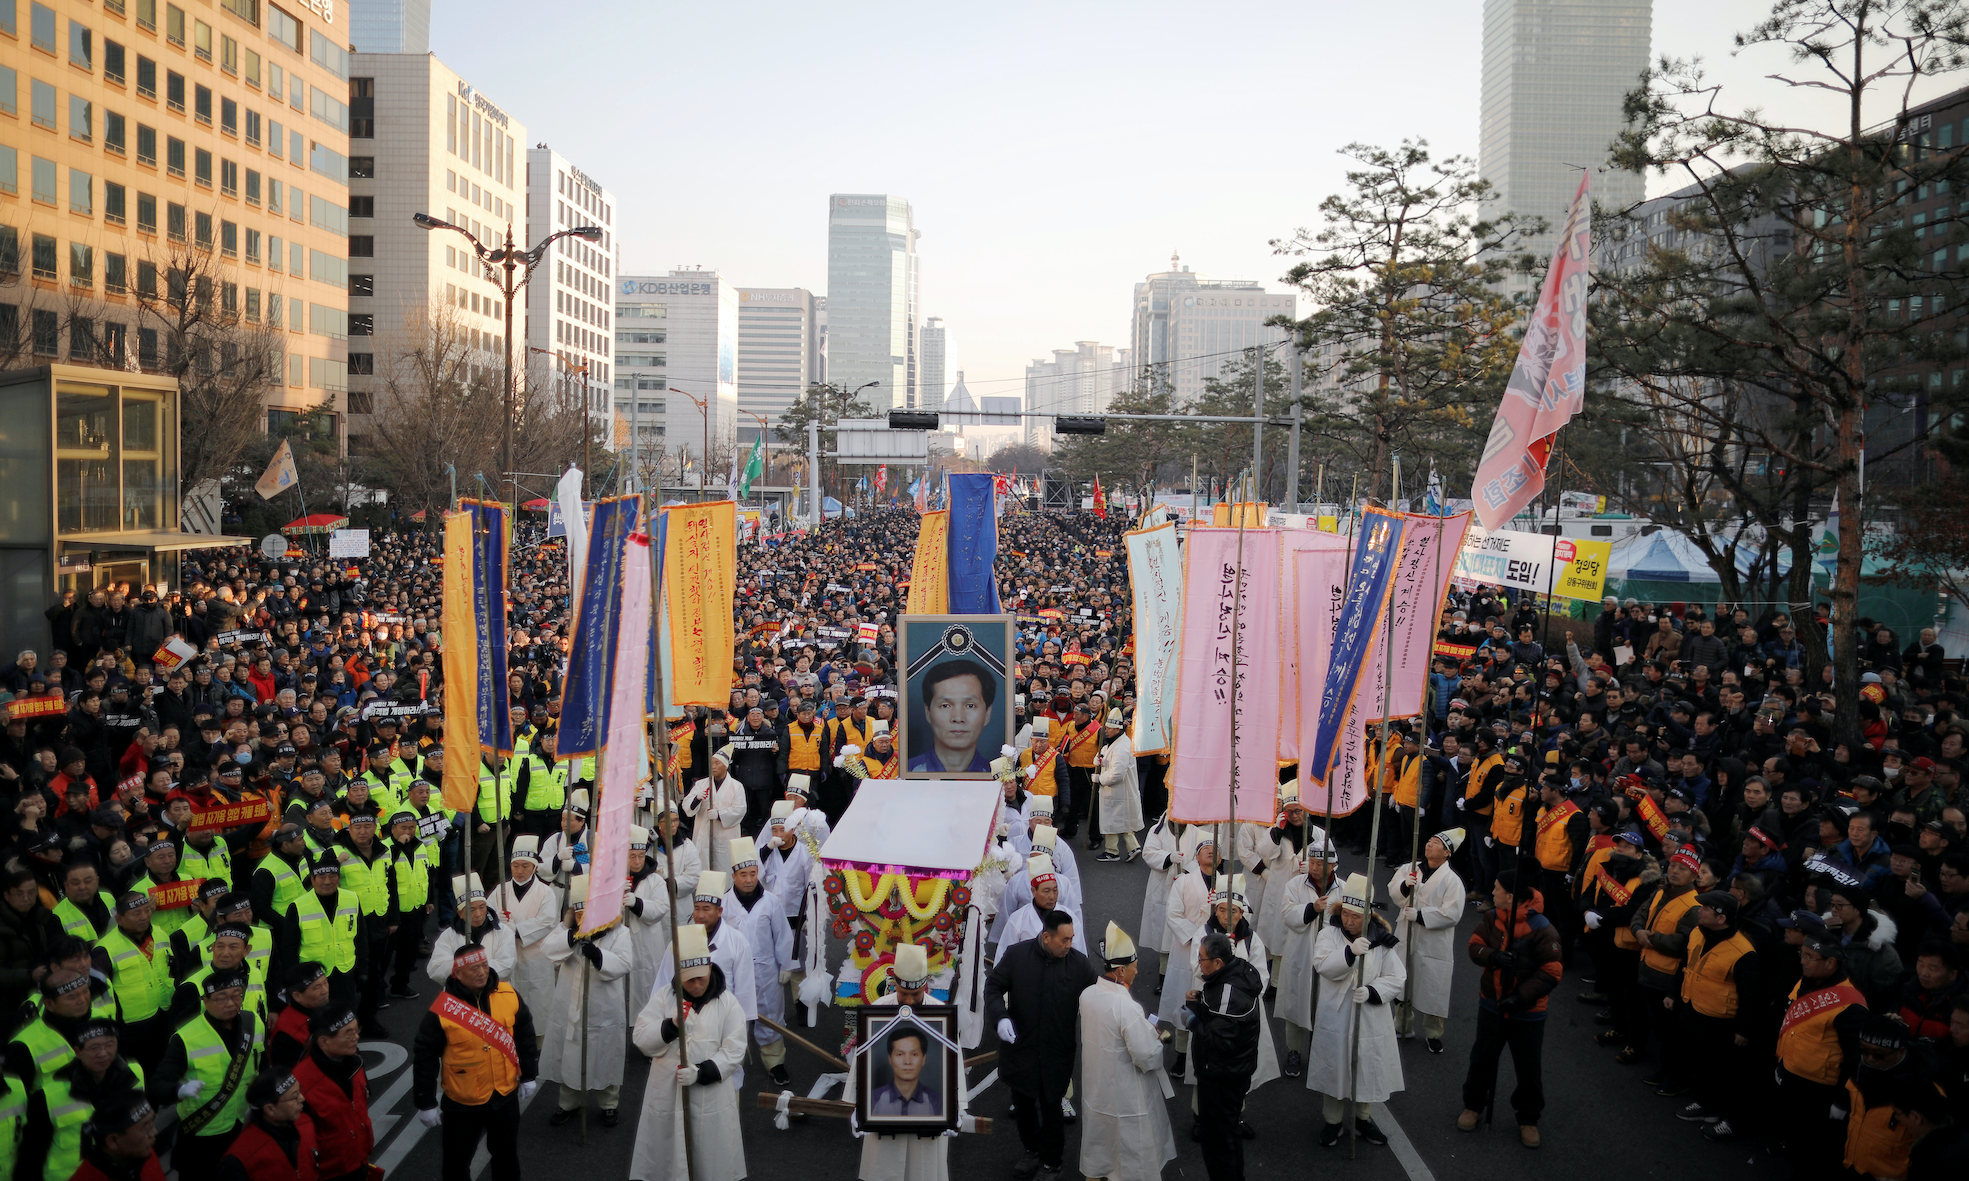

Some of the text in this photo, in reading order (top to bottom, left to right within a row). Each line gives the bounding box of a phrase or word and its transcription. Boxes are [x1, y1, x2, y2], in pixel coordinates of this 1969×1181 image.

[639, 282, 711, 295] KDB산업은행
[1481, 536, 1511, 552] 선거제도
[60, 556, 71, 566] 1F
[1575, 559, 1600, 576] 정의당
[1506, 559, 1540, 585] 도입!
[1395, 536, 1430, 628] 열사정신 계승!!
[1566, 577, 1598, 590] 강동구위원회
[19, 702, 34, 714] 자가용
[34, 701, 44, 713] 영업
[44, 700, 54, 711] 카풀
[191, 812, 204, 827] 불법
[205, 810, 226, 825] 자가용
[227, 807, 240, 822] 영업
[241, 805, 253, 819] 카풀
[166, 886, 188, 904] 자가용
